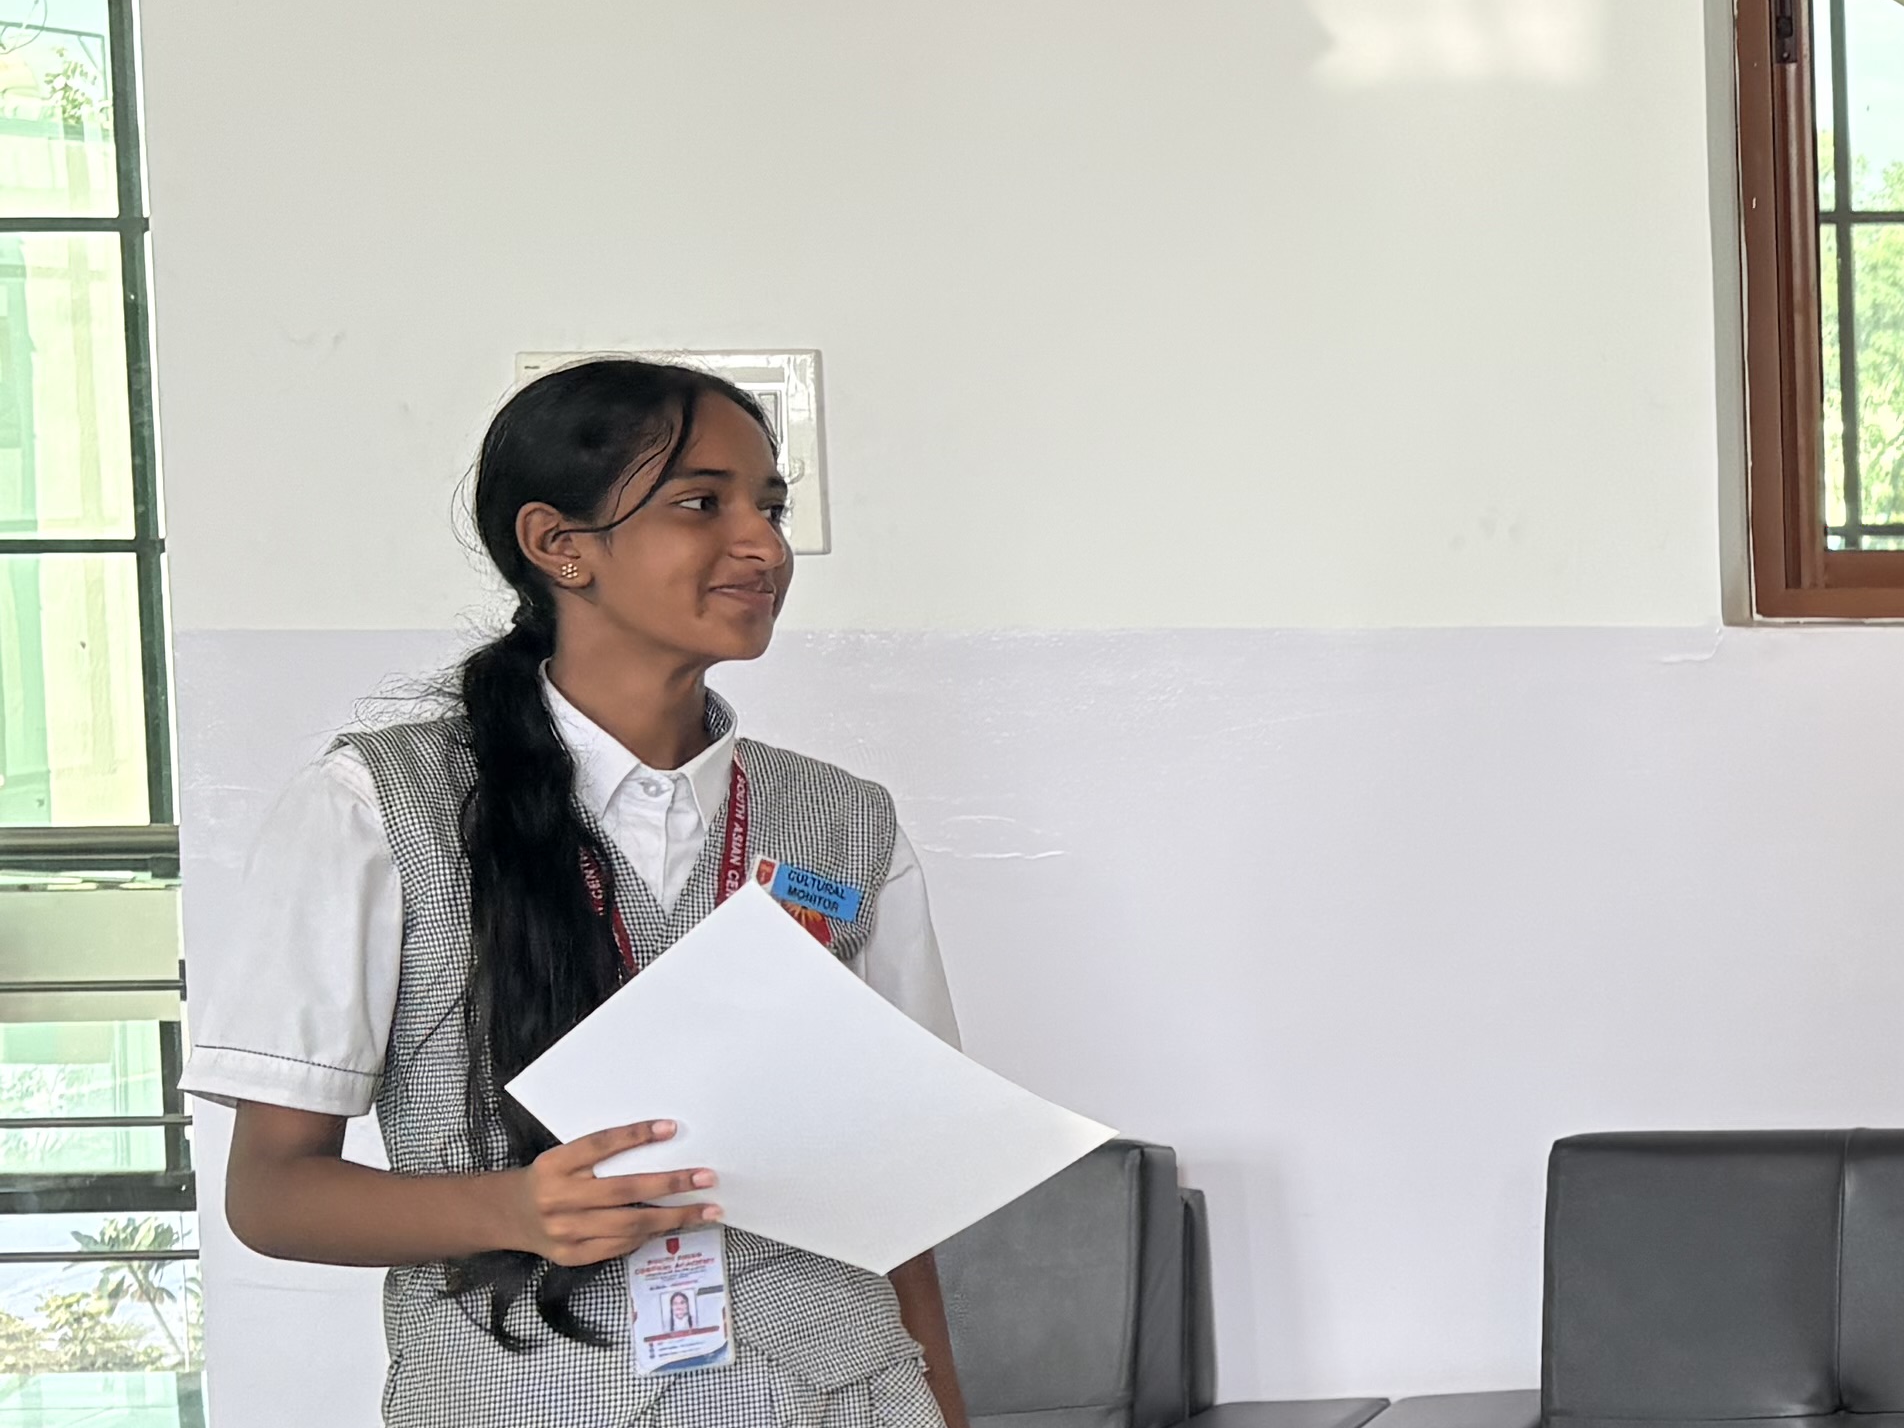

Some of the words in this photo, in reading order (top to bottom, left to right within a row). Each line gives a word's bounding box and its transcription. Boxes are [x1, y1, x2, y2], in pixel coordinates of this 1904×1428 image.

[735, 775, 747, 820] SOUTH
[729, 823, 744, 866] ASIAN
[787, 869, 847, 900] CULTURAL
[787, 885, 839, 912] MONITOR
